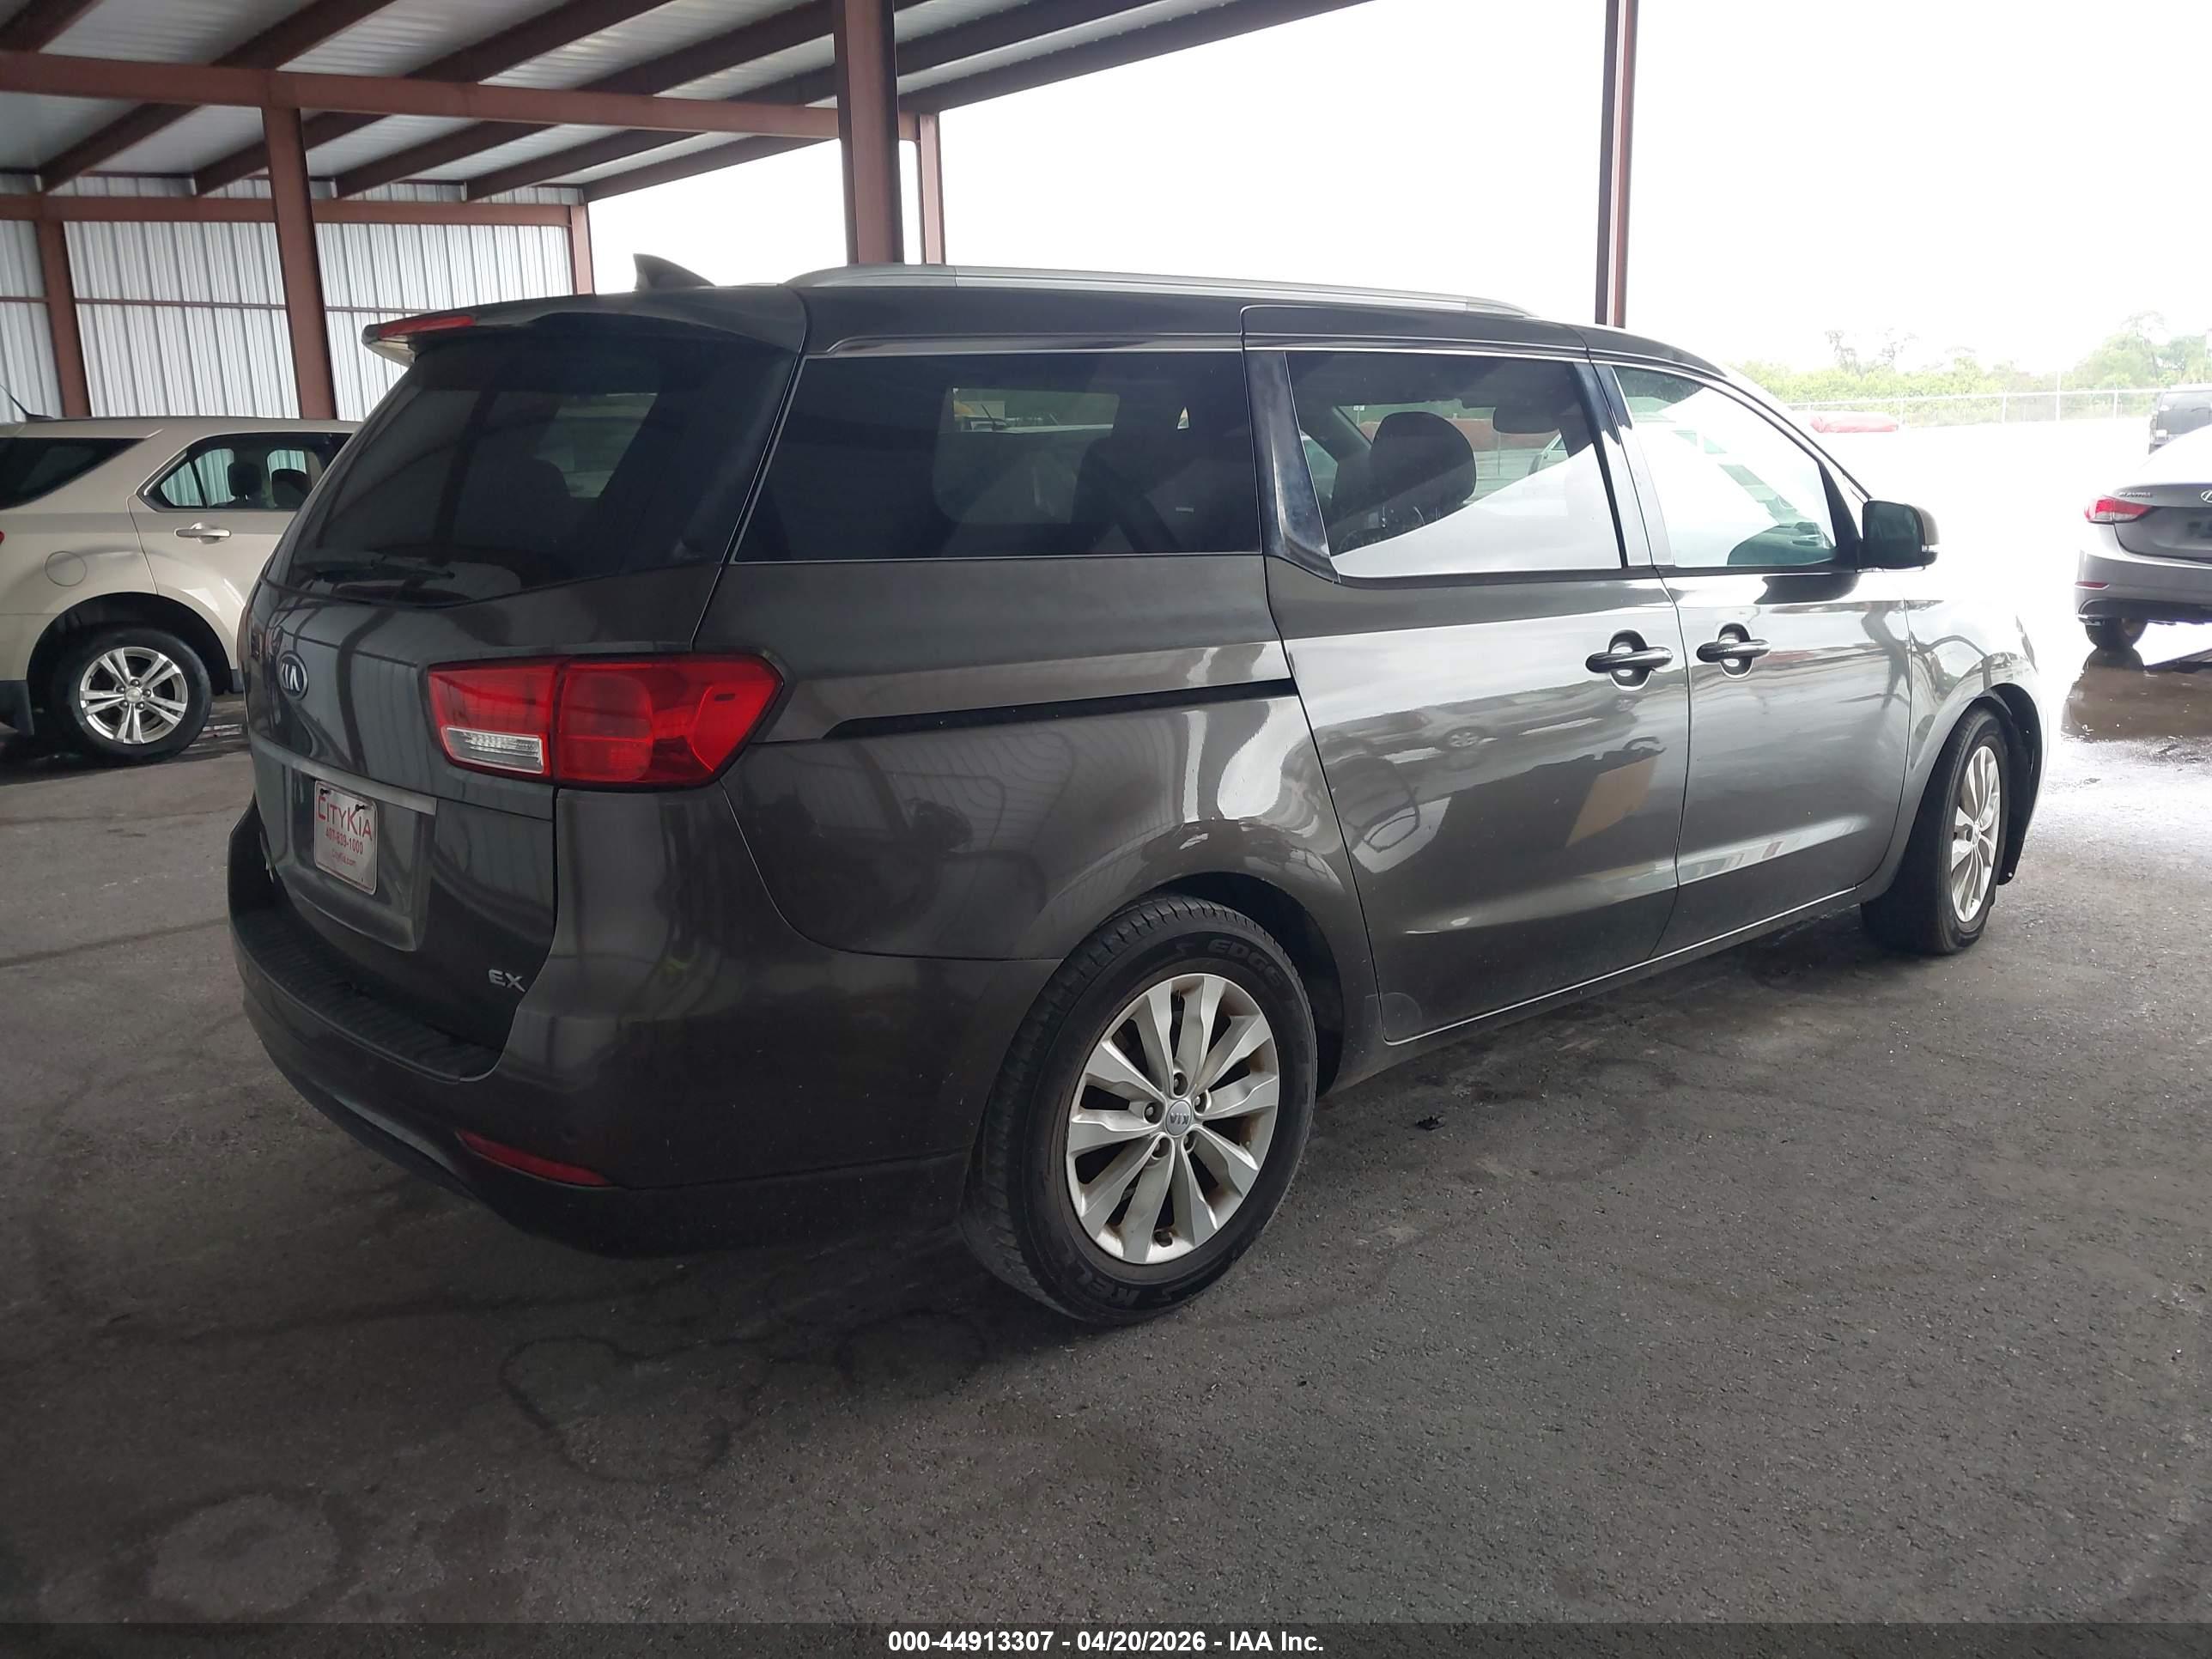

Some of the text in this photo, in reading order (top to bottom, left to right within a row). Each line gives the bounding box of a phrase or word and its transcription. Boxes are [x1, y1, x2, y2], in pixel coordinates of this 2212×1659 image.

[1207, 939, 1285, 987] EDGE
[488, 969, 526, 993] EX
[1170, 1112, 1189, 1125] KIA
